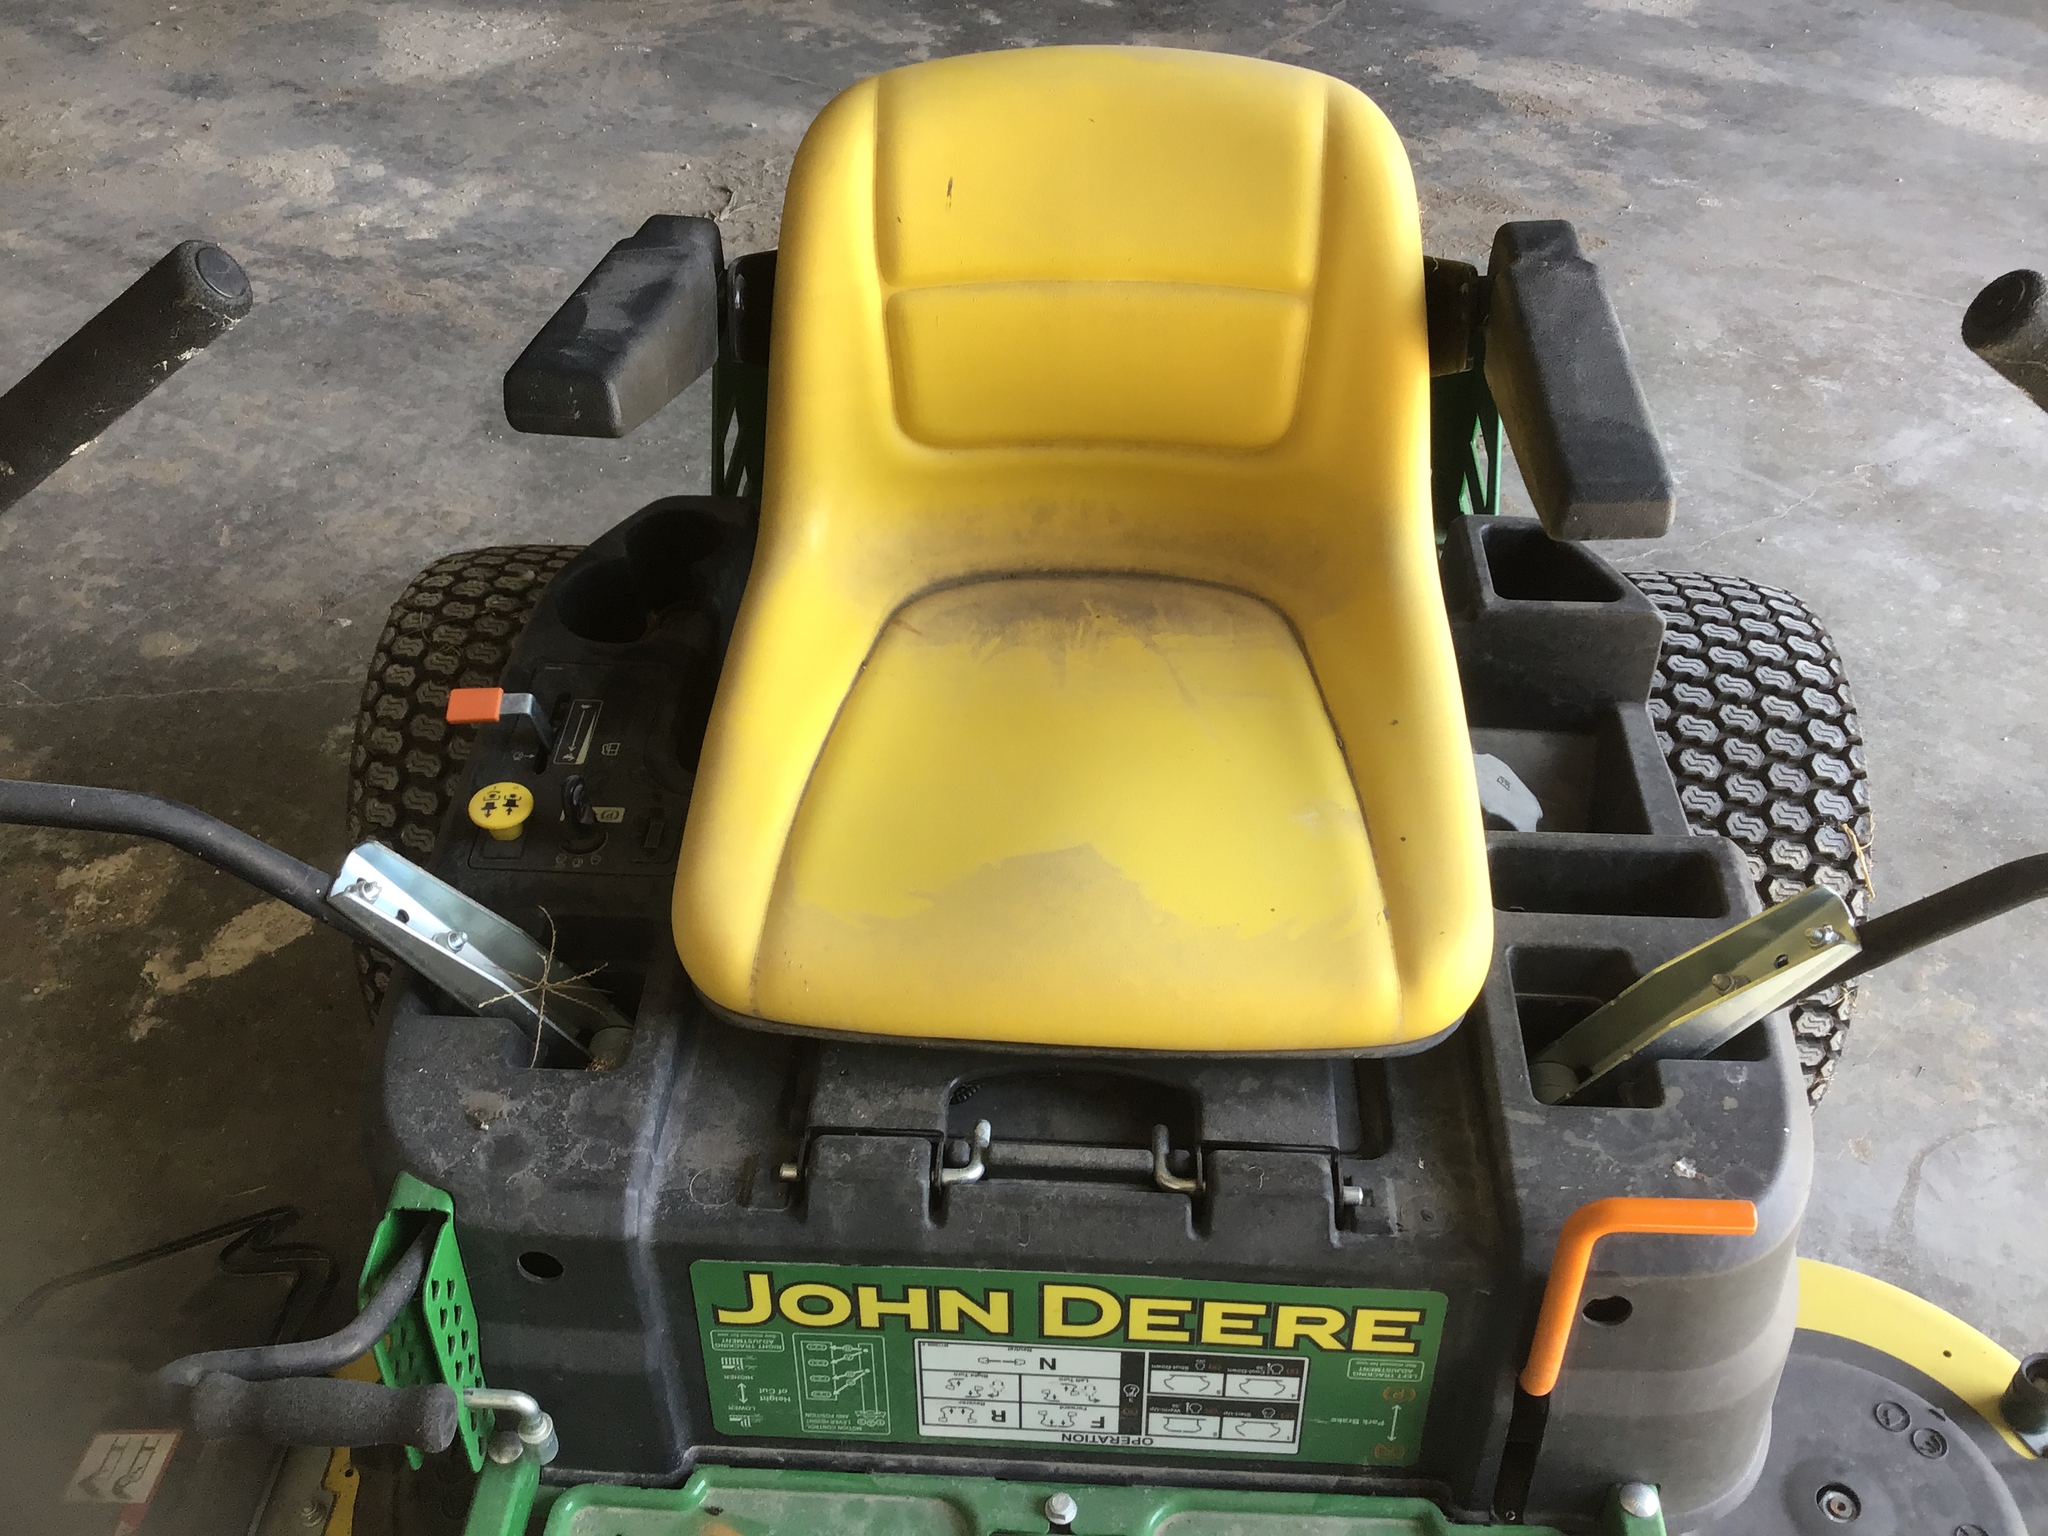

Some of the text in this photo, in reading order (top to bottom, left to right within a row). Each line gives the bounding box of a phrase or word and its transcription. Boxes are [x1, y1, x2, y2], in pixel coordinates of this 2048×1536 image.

[715, 1272, 1421, 1354] JOHN DEERE
[1039, 1357, 1057, 1371] N
[759, 1387, 776, 1395] Cut
[759, 1394, 791, 1403] Height
[991, 1410, 1006, 1423] R
[1090, 1416, 1105, 1429] F
[1330, 1417, 1359, 1425] Brake
[1061, 1433, 1154, 1446] OPERATION
